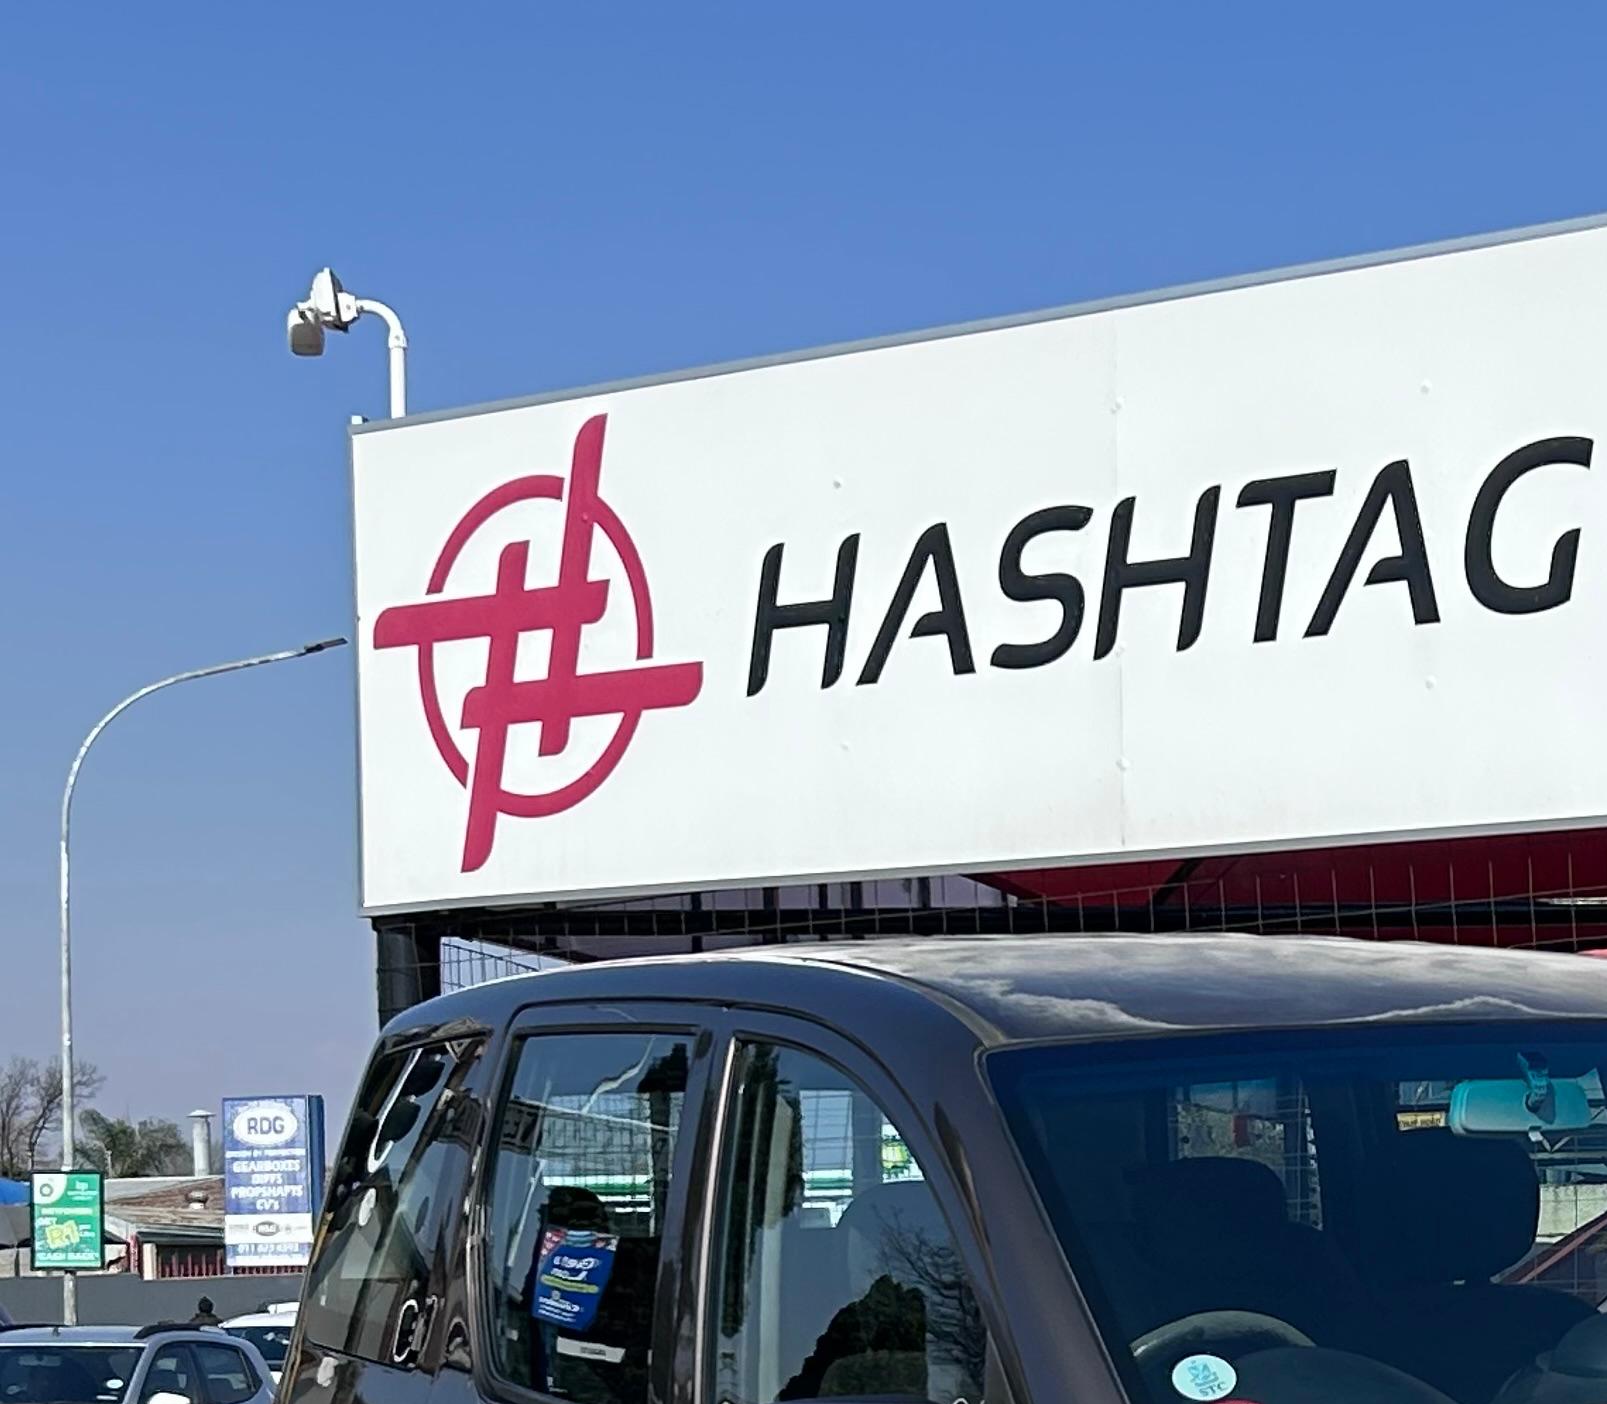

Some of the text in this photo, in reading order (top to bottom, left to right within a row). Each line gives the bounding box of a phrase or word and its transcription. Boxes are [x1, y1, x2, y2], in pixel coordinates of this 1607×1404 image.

[746, 436, 1594, 698] HASHTAG
[247, 1116, 285, 1135] RDG
[233, 1160, 301, 1173] GEARBOXES
[231, 1185, 304, 1199] PROPSHAFTS
